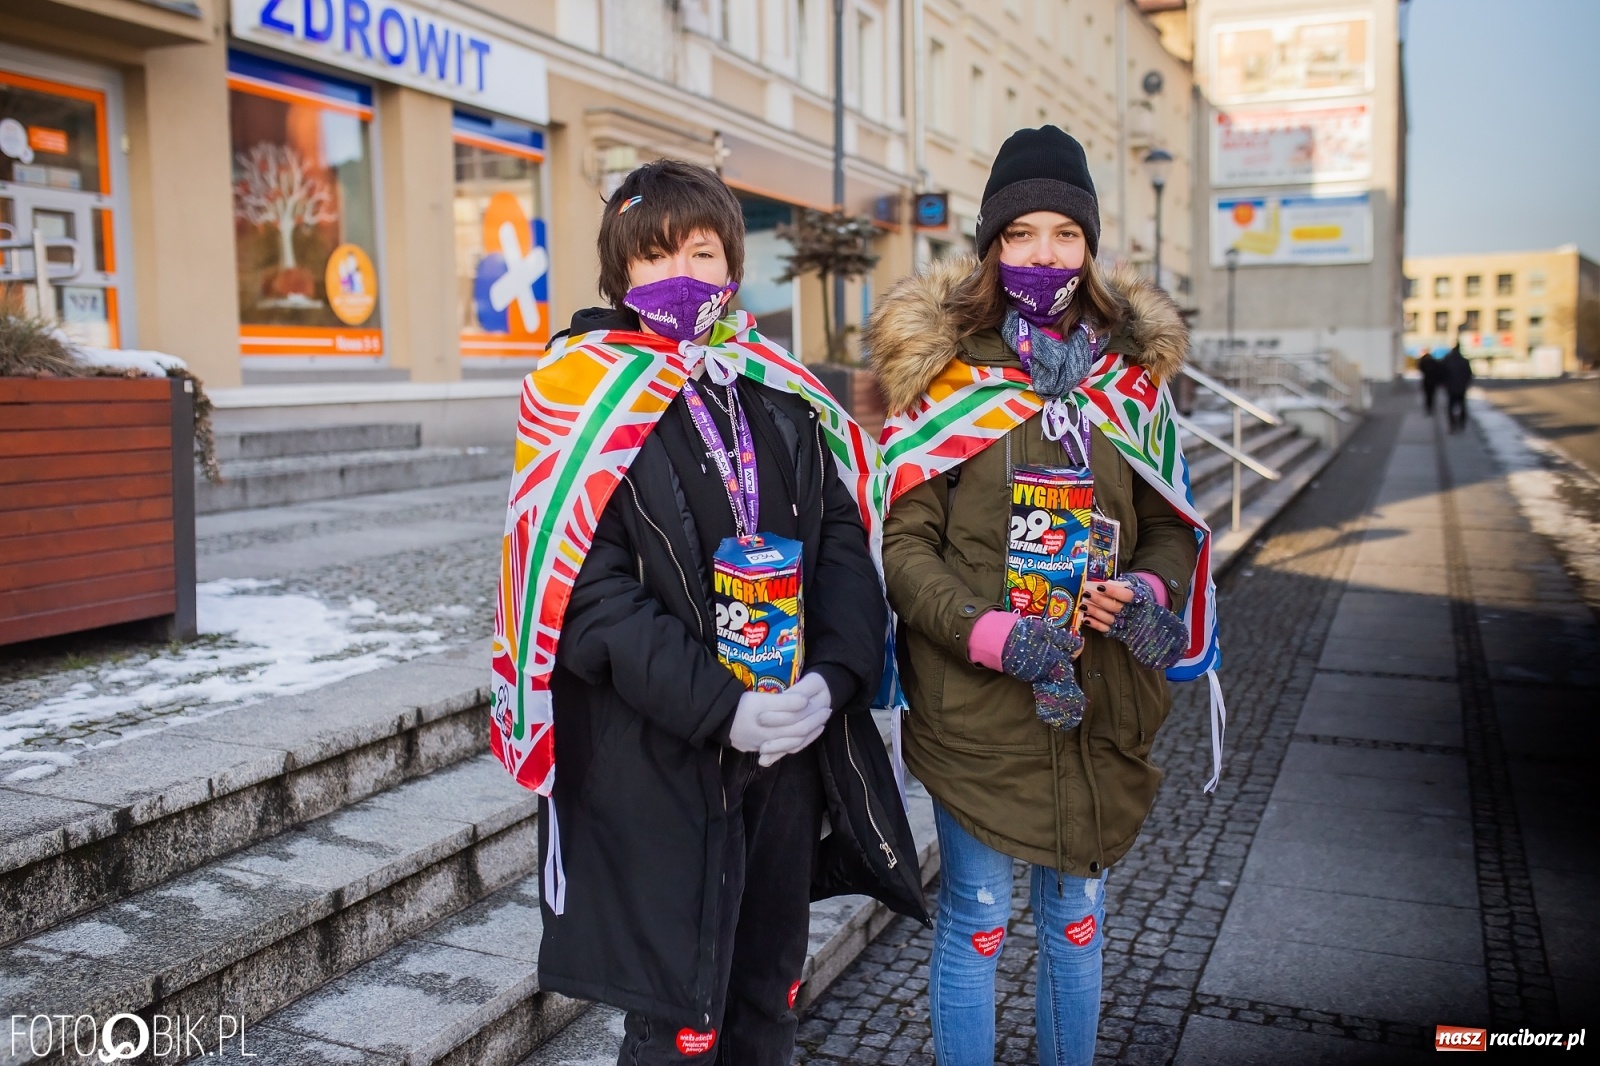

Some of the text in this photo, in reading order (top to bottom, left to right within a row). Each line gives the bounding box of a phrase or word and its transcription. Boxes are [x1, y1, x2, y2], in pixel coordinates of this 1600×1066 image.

[261, 0, 490, 91] ZDROWIT
[716, 450, 729, 472] PLAY
[1011, 510, 1051, 541] 29
